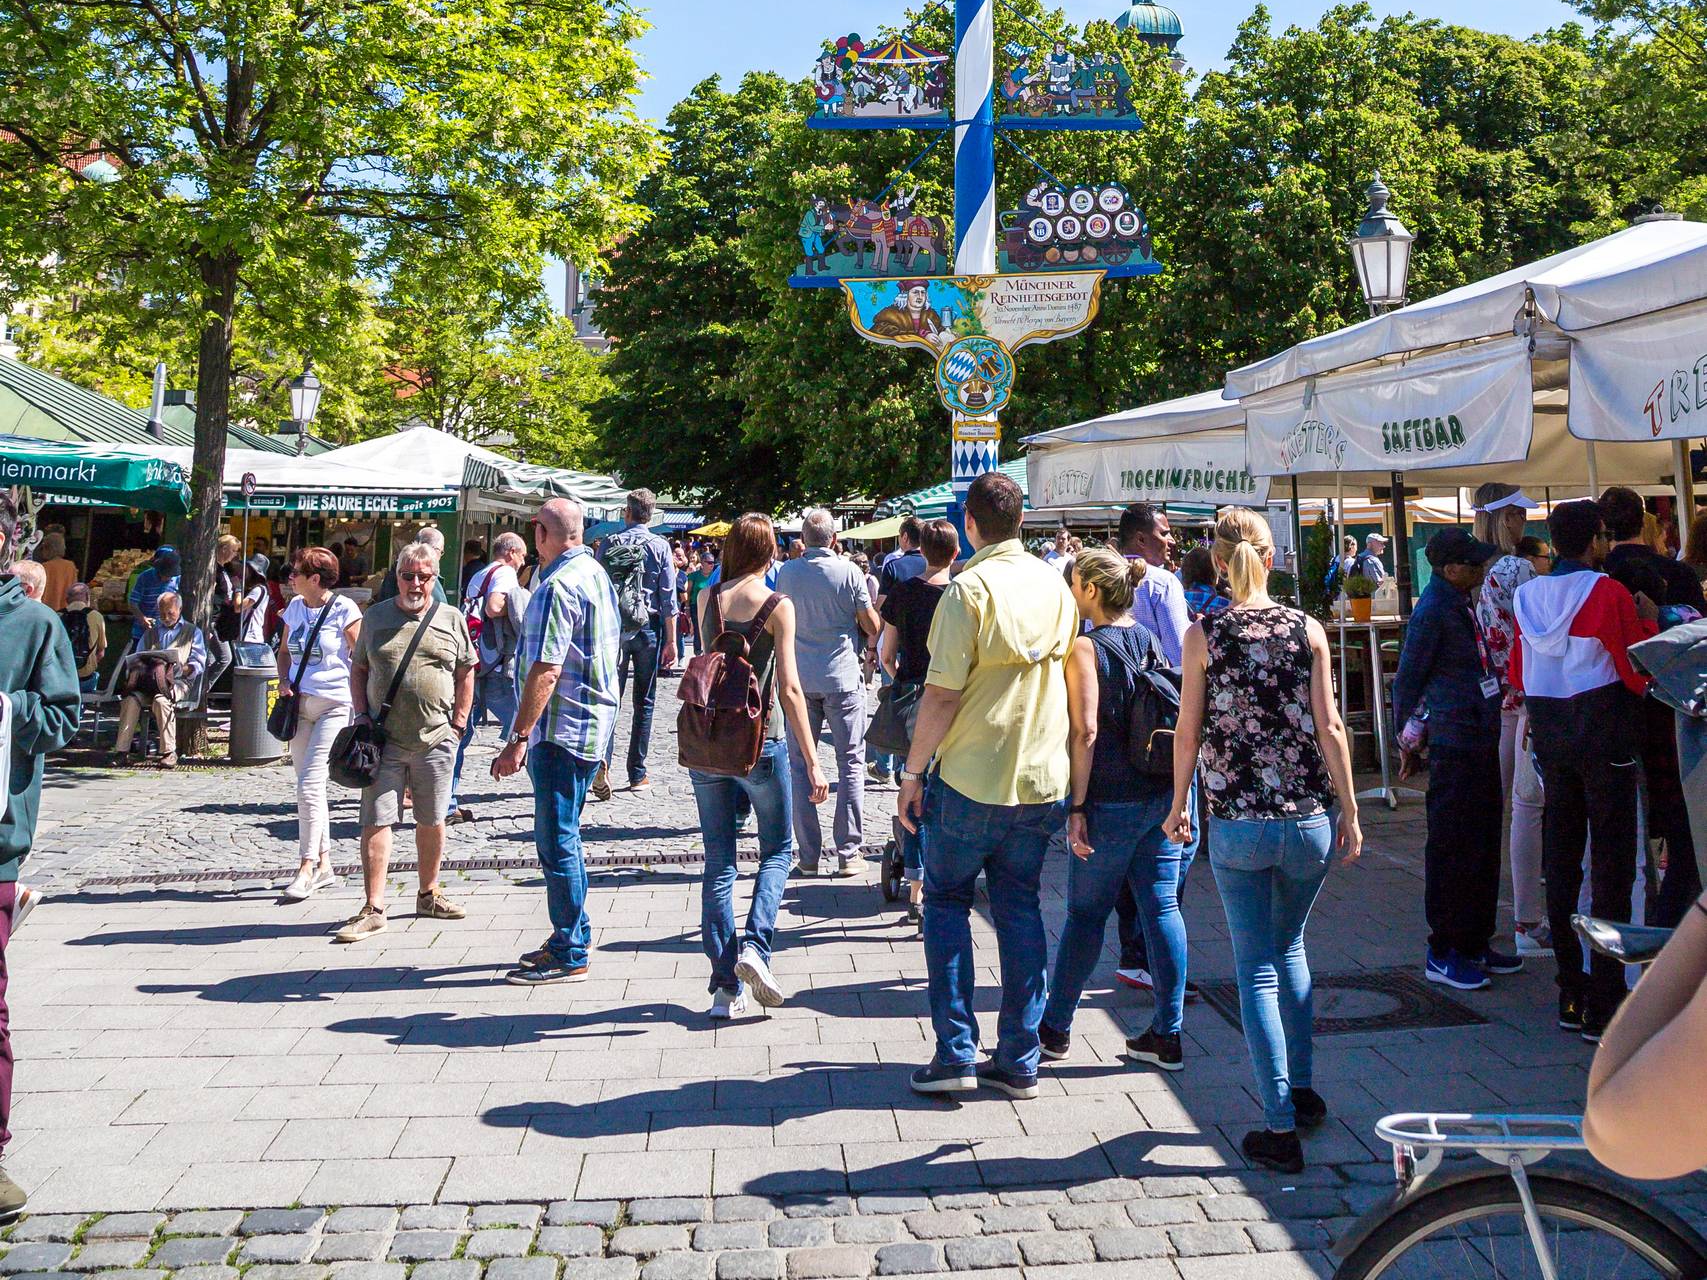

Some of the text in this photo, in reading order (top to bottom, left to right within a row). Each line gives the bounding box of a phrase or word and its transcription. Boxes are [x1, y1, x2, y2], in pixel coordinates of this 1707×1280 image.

[1005, 279, 1076, 291] MÜNCHNER
[991, 292, 1088, 306] REINHEITSGEBOT
[1381, 414, 1467, 455] SAFTBAR
[298, 495, 453, 511] DIE SAURE ECKE seit 1903
